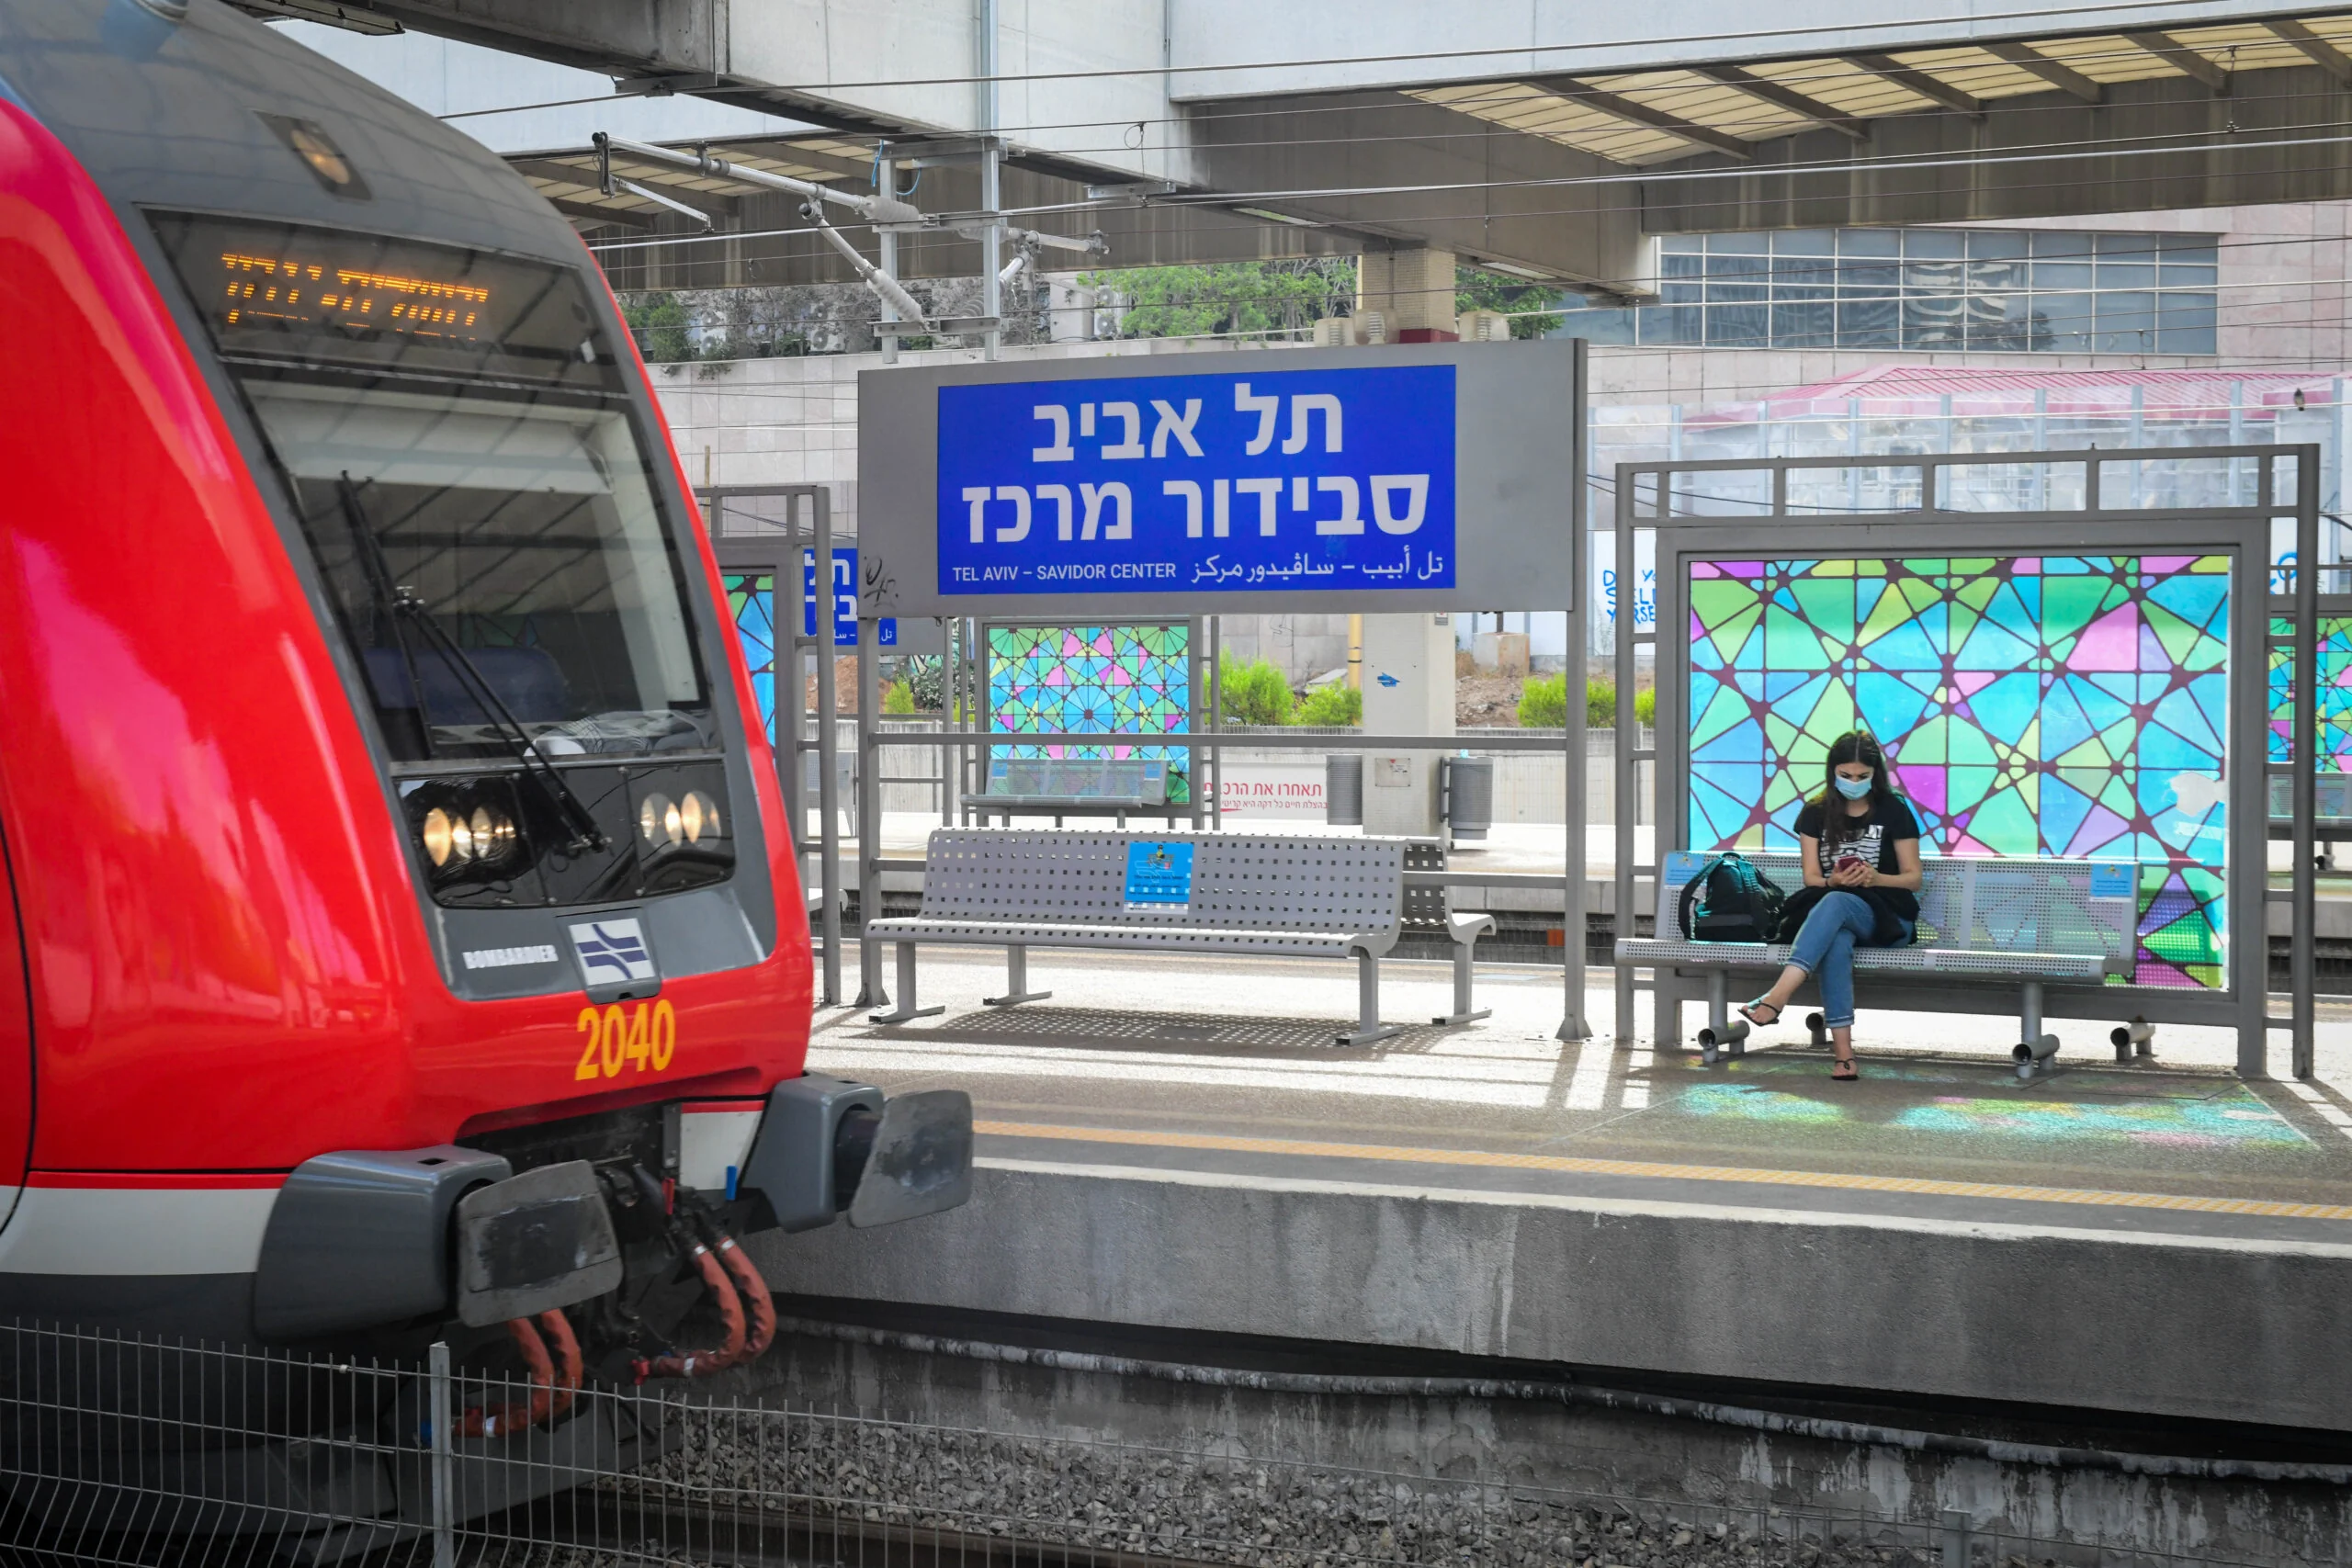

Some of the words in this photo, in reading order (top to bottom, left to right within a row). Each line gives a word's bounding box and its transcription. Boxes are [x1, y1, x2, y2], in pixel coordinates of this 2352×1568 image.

[1033, 399, 1204, 462] אביב
[1236, 381, 1342, 456] תל
[962, 481, 1132, 543] מרכז
[1163, 474, 1430, 538] סבידור
[953, 567, 979, 581] TEL
[983, 566, 1019, 581] AVIV
[1037, 563, 1106, 580] SAVIDOR
[1111, 562, 1177, 579] CENTER
[1192, 554, 1243, 583] مركز
[1363, 545, 1410, 580] أبيب
[1418, 551, 1443, 581] تل
[1253, 783, 1273, 795] את
[1278, 783, 1322, 796] תאחרו
[575, 998, 675, 1081] 2040
